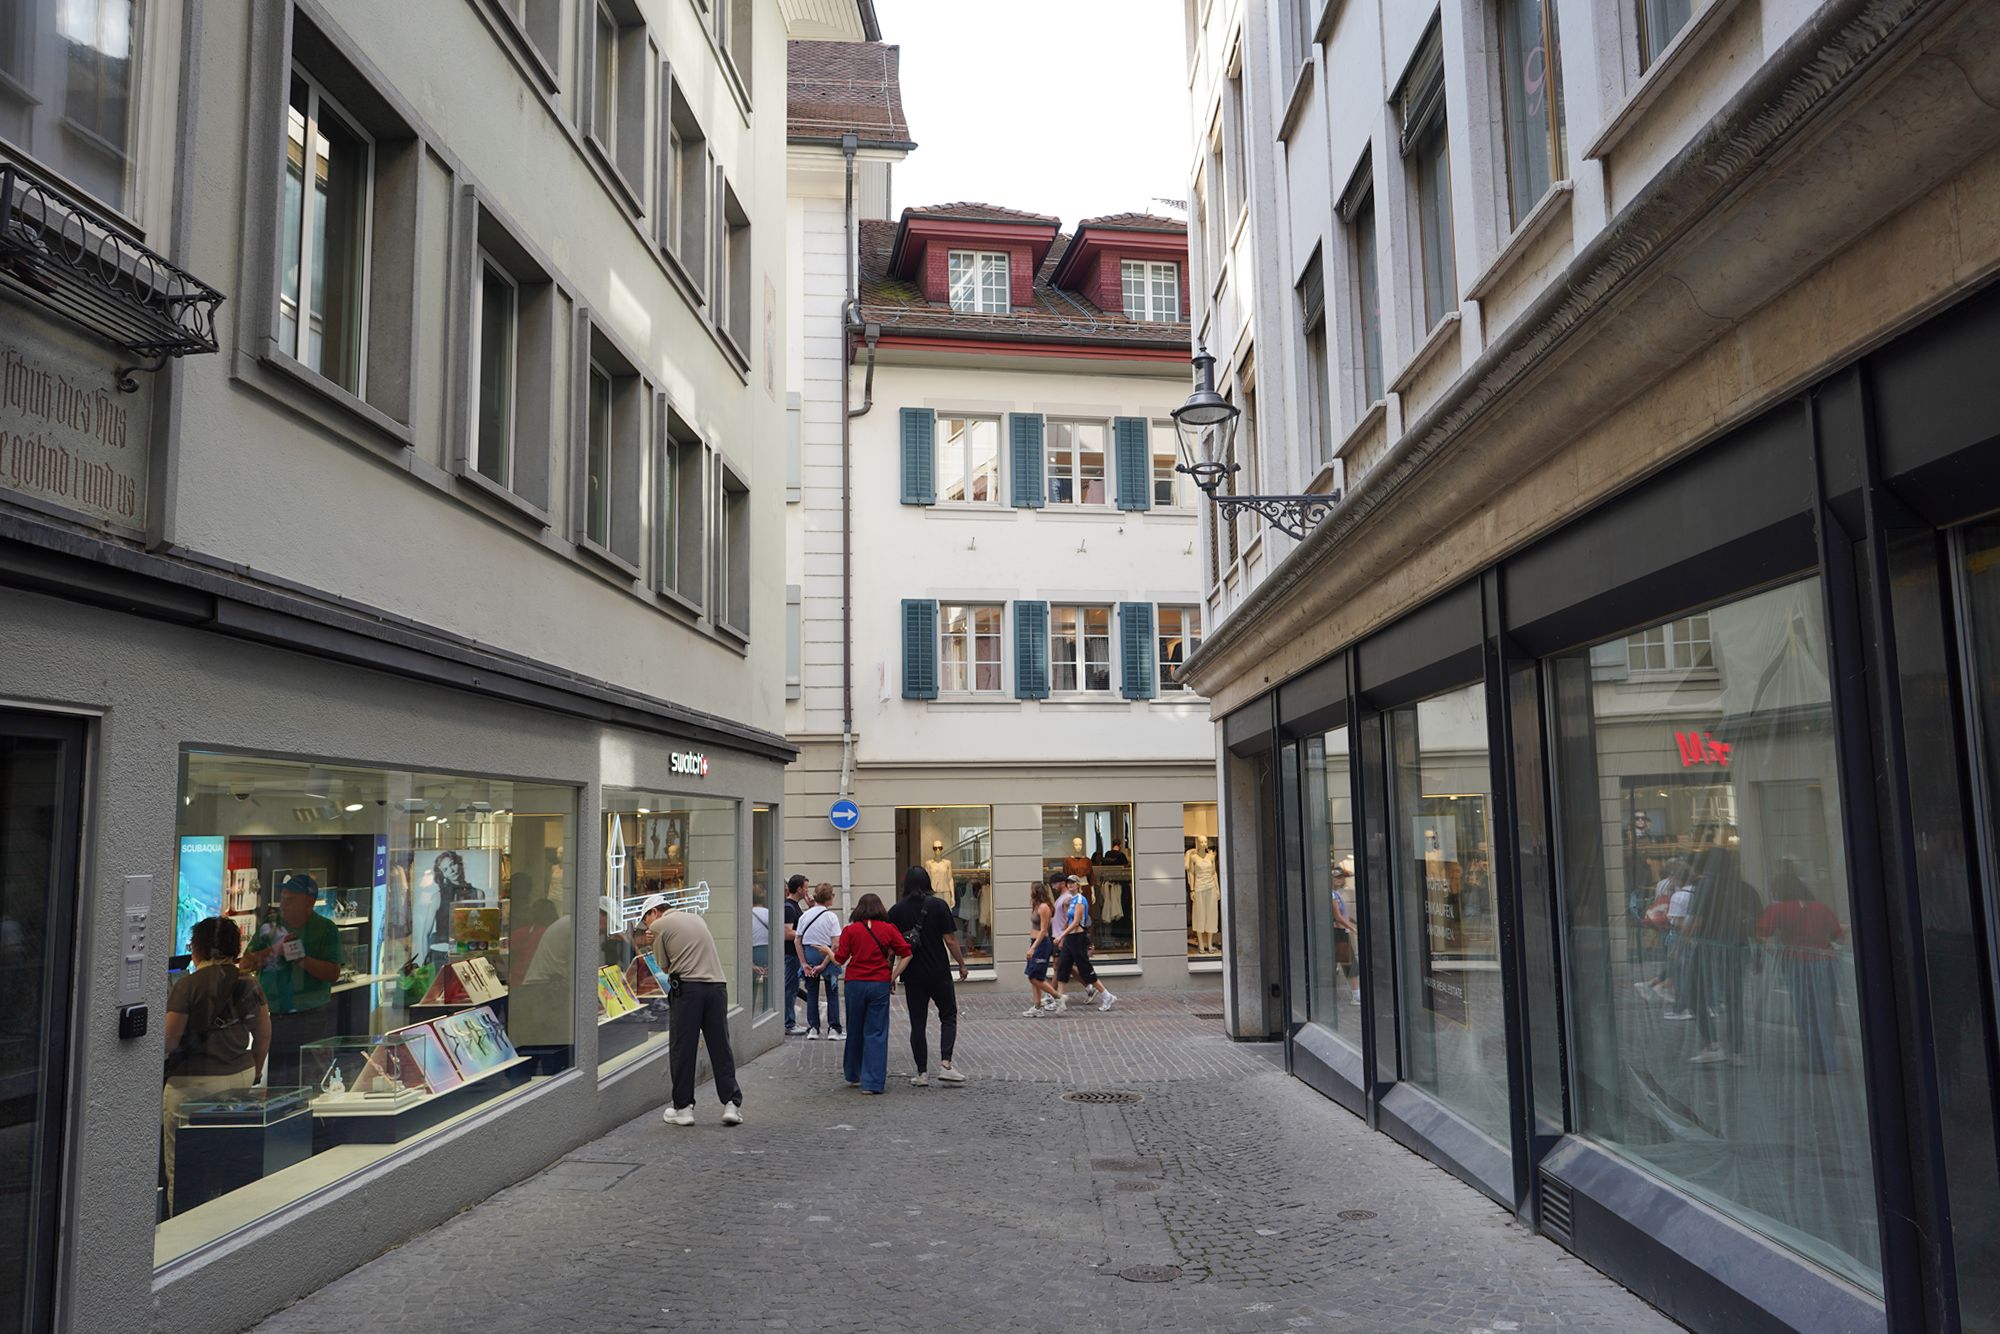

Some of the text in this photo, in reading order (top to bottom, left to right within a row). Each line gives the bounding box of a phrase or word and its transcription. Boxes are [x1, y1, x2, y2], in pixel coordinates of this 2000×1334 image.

[56, 373, 90, 434] dies
[83, 459, 114, 511] und
[117, 473, 136, 518] us
[670, 751, 703, 775] swatch
[181, 843, 223, 854] SCUBAQUA
